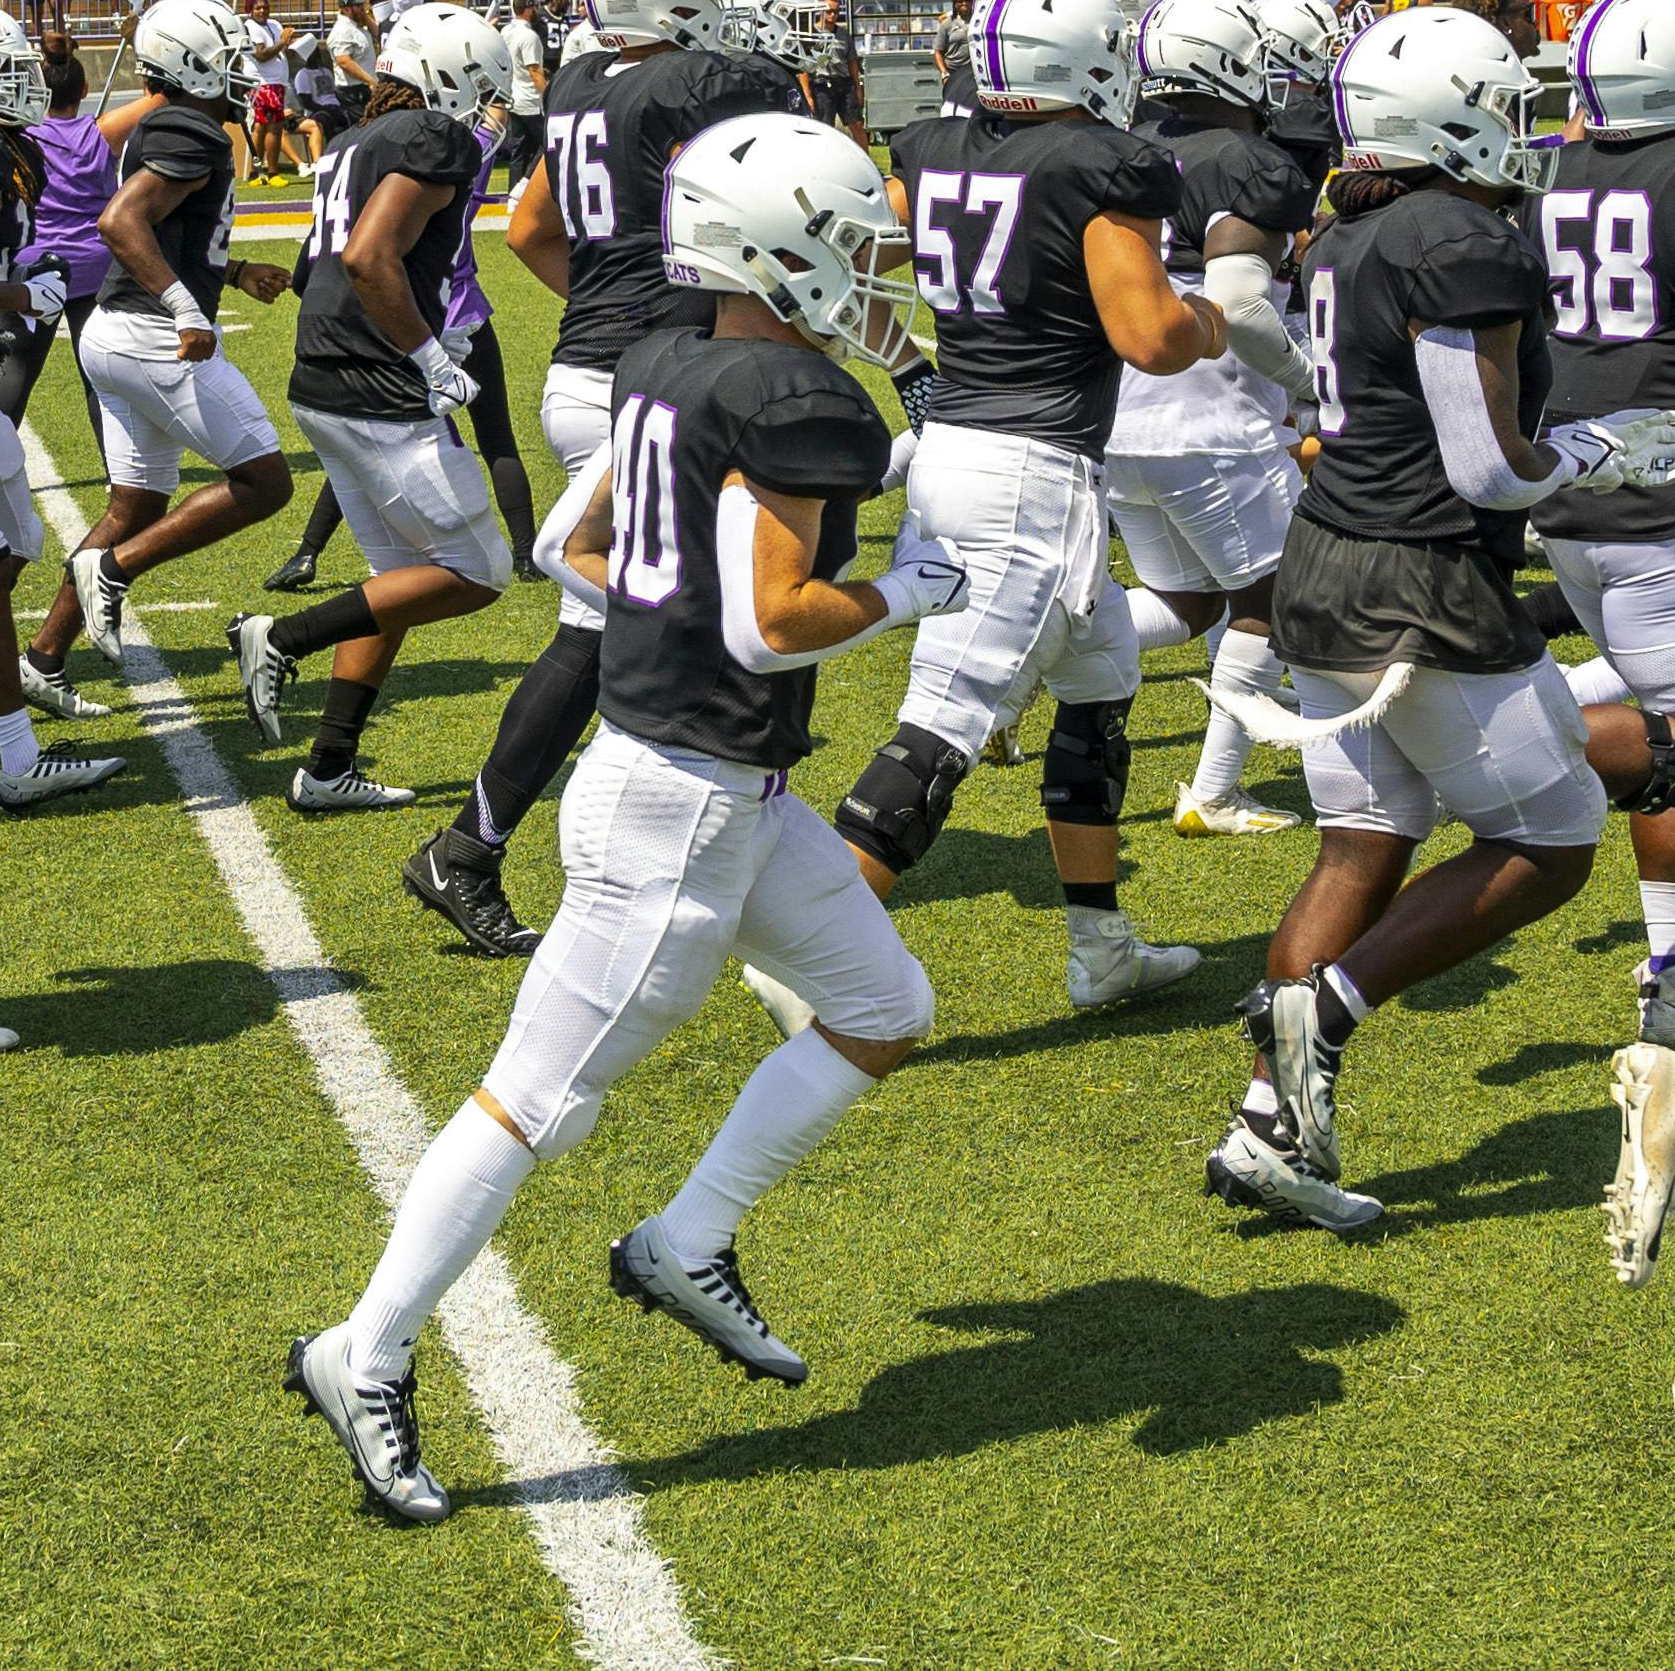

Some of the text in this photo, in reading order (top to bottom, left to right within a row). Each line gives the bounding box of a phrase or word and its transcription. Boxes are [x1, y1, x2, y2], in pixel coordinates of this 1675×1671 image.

[546, 109, 618, 241] 76
[979, 95, 1038, 112] Riddell
[913, 168, 1026, 314] 57
[1540, 189, 1659, 341] 58
[607, 392, 684, 609] 40
